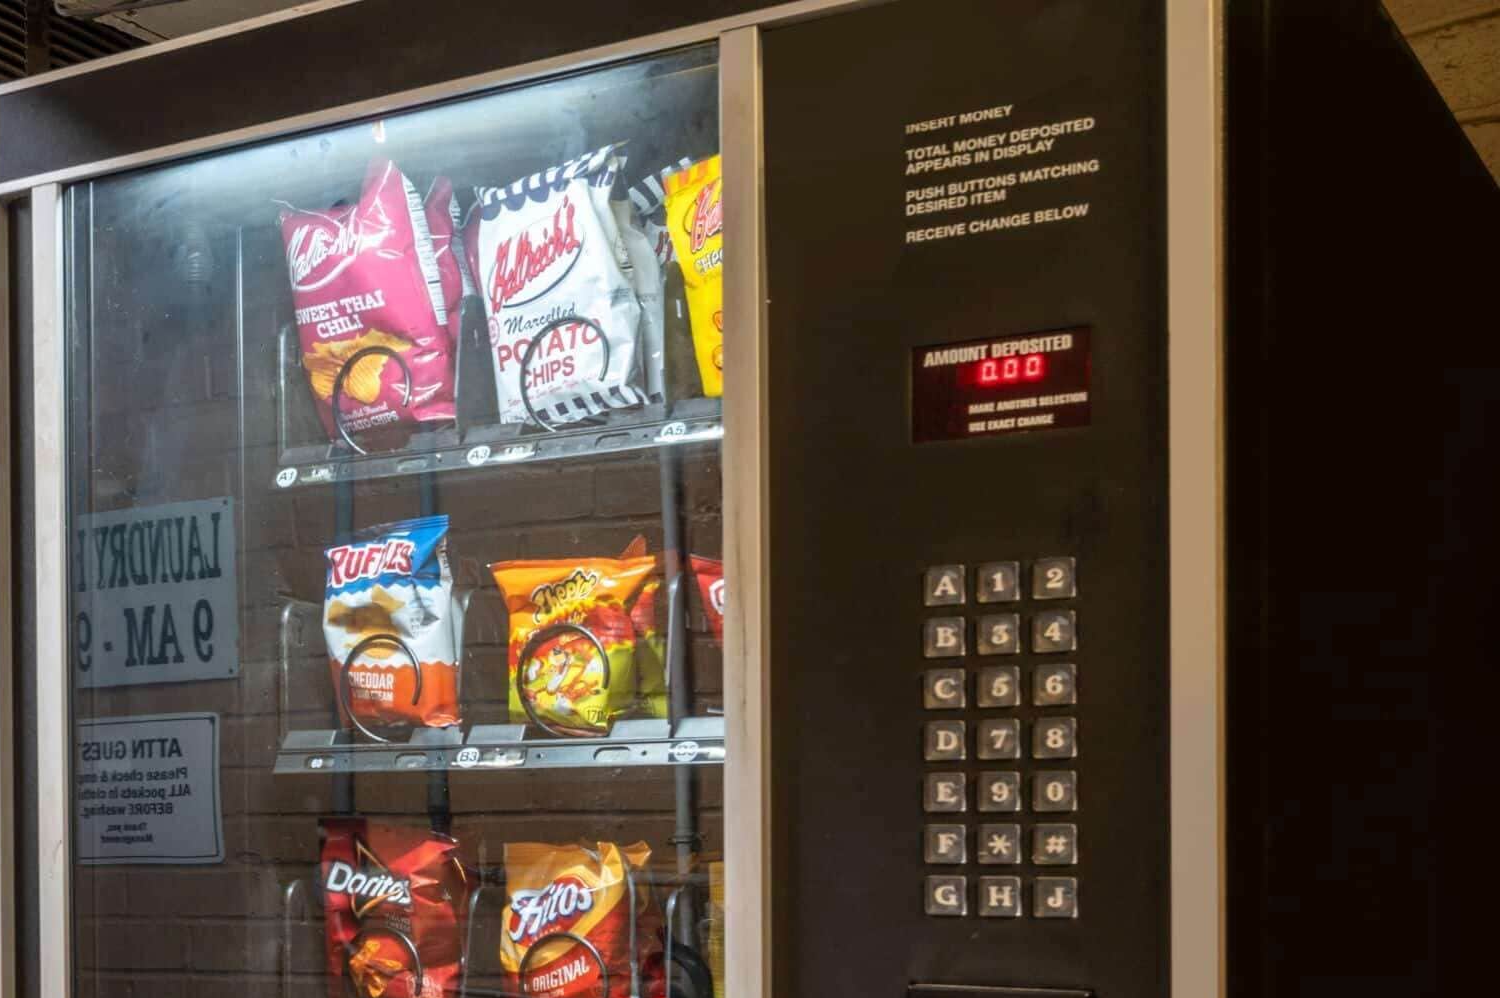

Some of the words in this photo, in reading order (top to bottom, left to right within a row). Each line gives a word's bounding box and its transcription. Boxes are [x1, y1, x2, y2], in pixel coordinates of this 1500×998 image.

[906, 115, 956, 134] INSERT
[959, 104, 1013, 125] MONEY
[906, 143, 950, 161] TOTAL
[953, 132, 1006, 152] MONEY
[1010, 116, 1095, 142] DEPOSITED
[906, 154, 971, 175] APPEARS
[975, 149, 990, 163] IN
[993, 138, 1055, 160] DISPLAY
[906, 185, 945, 203] PUSH
[948, 173, 1016, 196] BUTTONS
[1020, 159, 1099, 184] MATCHING
[906, 196, 967, 216] DESIRED
[971, 190, 1006, 206] ITEM
[906, 223, 966, 243] RECEIVE
[969, 213, 1031, 234] CHANGE
[1034, 203, 1089, 223] BELOW
[295, 301, 339, 326] SWEET
[340, 290, 386, 314] THAI
[504, 301, 577, 335] Marcelled
[316, 315, 364, 340] CHILI
[924, 344, 989, 367] AMOUNT
[992, 334, 1073, 358] DEPOSITED
[524, 355, 575, 390] CHIPS
[981, 354, 1043, 383] 0.00
[969, 401, 995, 414] MAKE
[997, 397, 1037, 412] ANOTHER
[1039, 391, 1087, 406] SELECTION
[969, 420, 985, 432] USE
[988, 416, 1016, 431] EXACT
[1018, 413, 1054, 428] CHANGE
[278, 469, 296, 483] A1
[934, 575, 957, 597] A
[992, 573, 1006, 592] 1
[1046, 567, 1065, 589] 2
[935, 626, 957, 649] B
[991, 625, 1009, 645] 3
[1044, 621, 1062, 642] 4
[348, 671, 395, 690] CHEDDAR
[933, 677, 956, 700] C
[991, 677, 1009, 698] 5
[1045, 674, 1064, 695] 6
[935, 730, 958, 751] D
[990, 729, 1008, 749] 7
[1046, 727, 1064, 749] 8
[458, 751, 479, 764] B3
[935, 782, 958, 803] E
[991, 781, 1010, 803] 9
[1046, 780, 1065, 802] 0
[935, 833, 958, 854] F
[326, 861, 412, 905] Doritos
[934, 885, 958, 906] G
[988, 885, 1012, 907] H
[1046, 887, 1065, 908] J
[509, 882, 593, 942] Fritos
[532, 956, 591, 993] ORIGINAL
